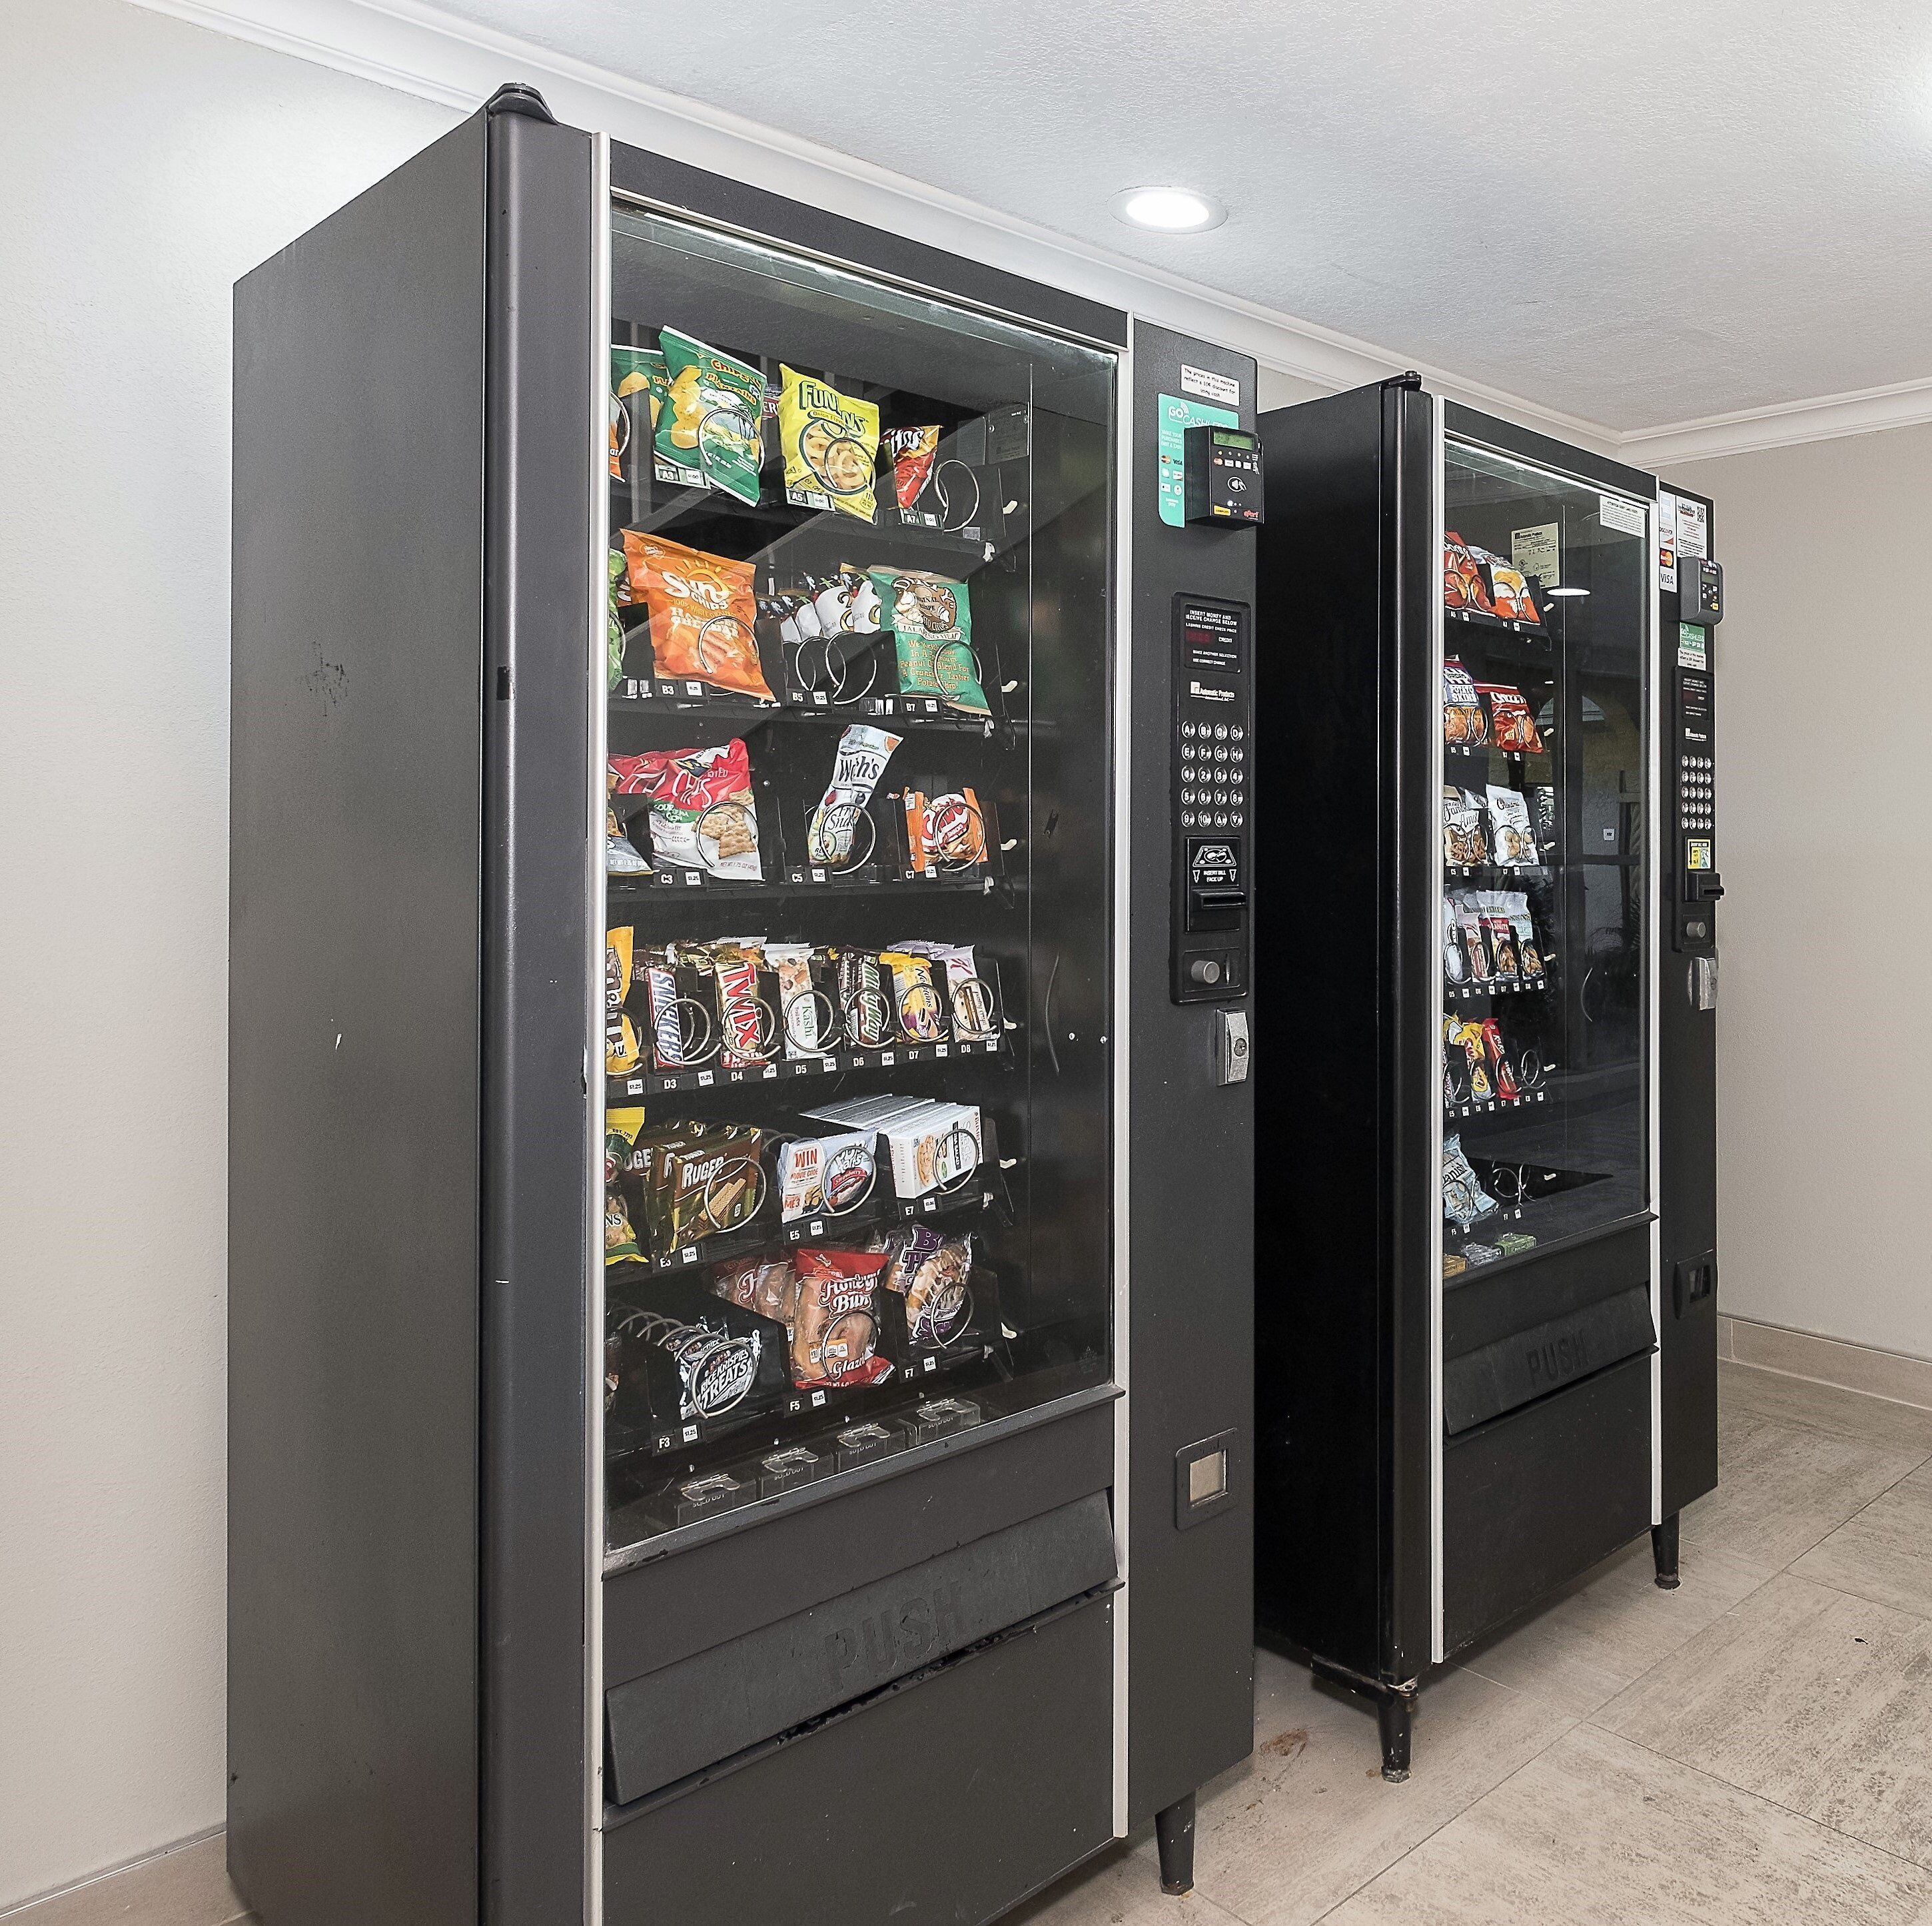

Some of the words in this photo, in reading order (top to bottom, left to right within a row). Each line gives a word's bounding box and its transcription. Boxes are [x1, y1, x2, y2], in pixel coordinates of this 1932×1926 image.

[799, 380, 865, 438] FUNNS
[1169, 405, 1183, 418] GO
[662, 470, 674, 480] A3
[791, 492, 804, 502] A5
[907, 514, 916, 524] A7
[1660, 574, 1674, 585] VISA
[662, 685, 674, 696] B3
[791, 692, 803, 702] B5
[906, 703, 916, 712] B7
[660, 874, 674, 884] C3
[791, 873, 803, 883] C5
[906, 870, 915, 879] C7
[723, 963, 761, 1048] TWIX
[801, 1005, 815, 1038] Kashi
[961, 1045, 971, 1053] D8
[909, 1051, 919, 1060] D7
[853, 1057, 864, 1067] D6
[795, 1065, 807, 1075] D5
[731, 1071, 743, 1081] D4
[664, 1079, 677, 1090] D3
[963, 1121, 973, 1162] Sack
[795, 1148, 817, 1168] WIN
[905, 1206, 915, 1216] E7
[789, 1230, 800, 1240] E5
[660, 1257, 672, 1268] E3
[831, 1295, 871, 1317] Bun
[701, 1370, 717, 1394] RICE
[716, 1349, 749, 1378] KRISPIES
[905, 1368, 914, 1378] F7
[700, 1360, 748, 1410] TREATS
[789, 1400, 801, 1412] F5
[658, 1437, 670, 1449] F3
[824, 1583, 963, 1695] PUSH
